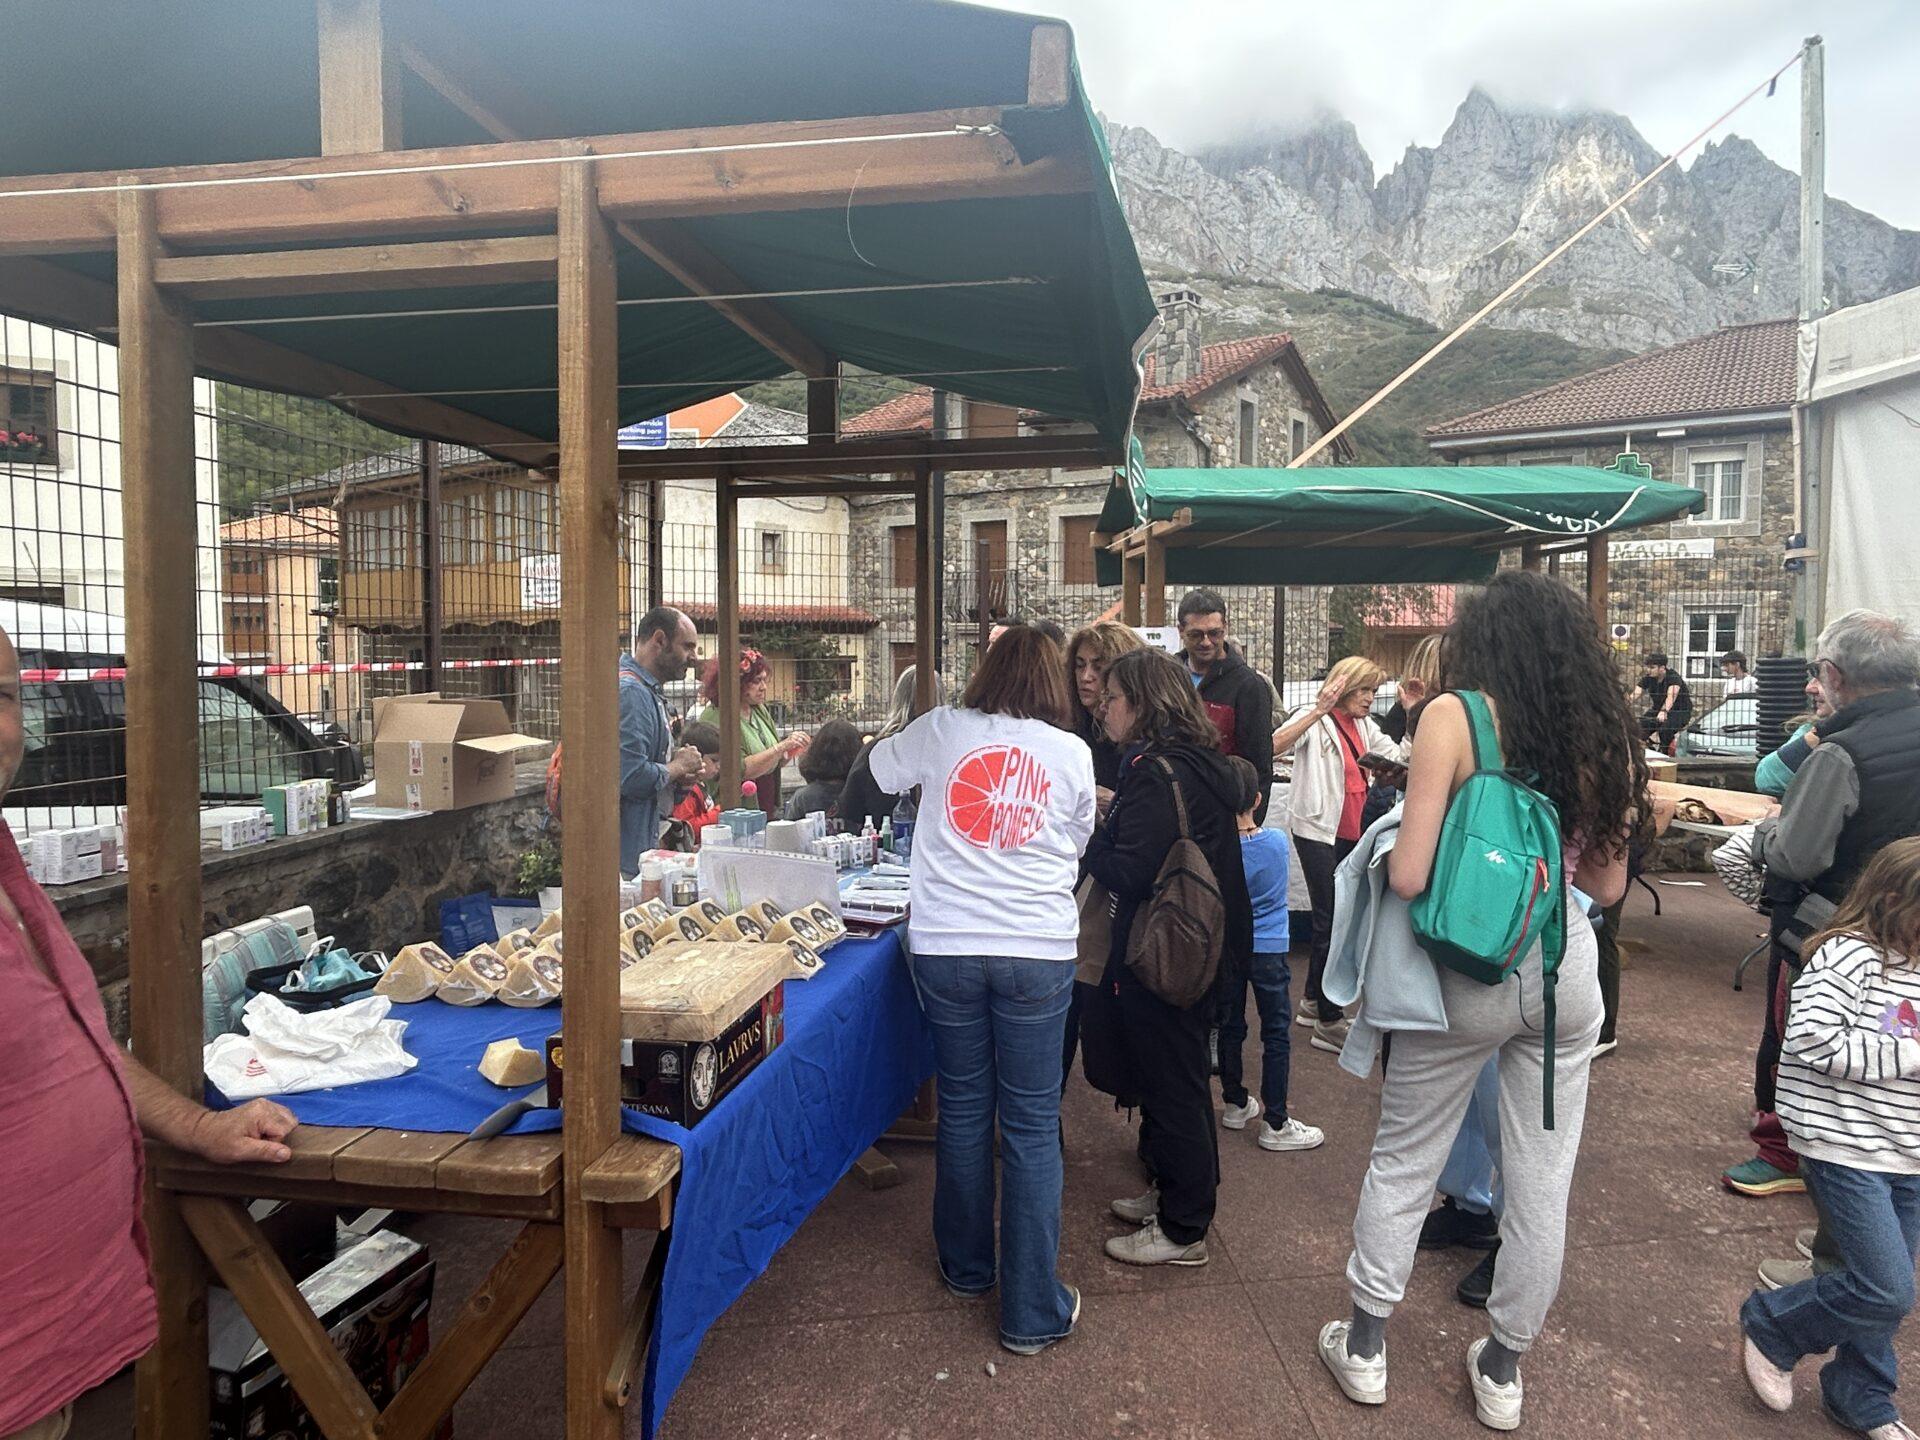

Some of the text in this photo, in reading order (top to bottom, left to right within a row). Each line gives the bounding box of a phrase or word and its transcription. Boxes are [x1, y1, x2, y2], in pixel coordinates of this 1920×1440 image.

[1001, 746, 1051, 807] PINK
[990, 802, 1045, 850] POMELO
[718, 1020, 761, 1075] LAVRVS
[622, 1102, 671, 1115] RTESANA
